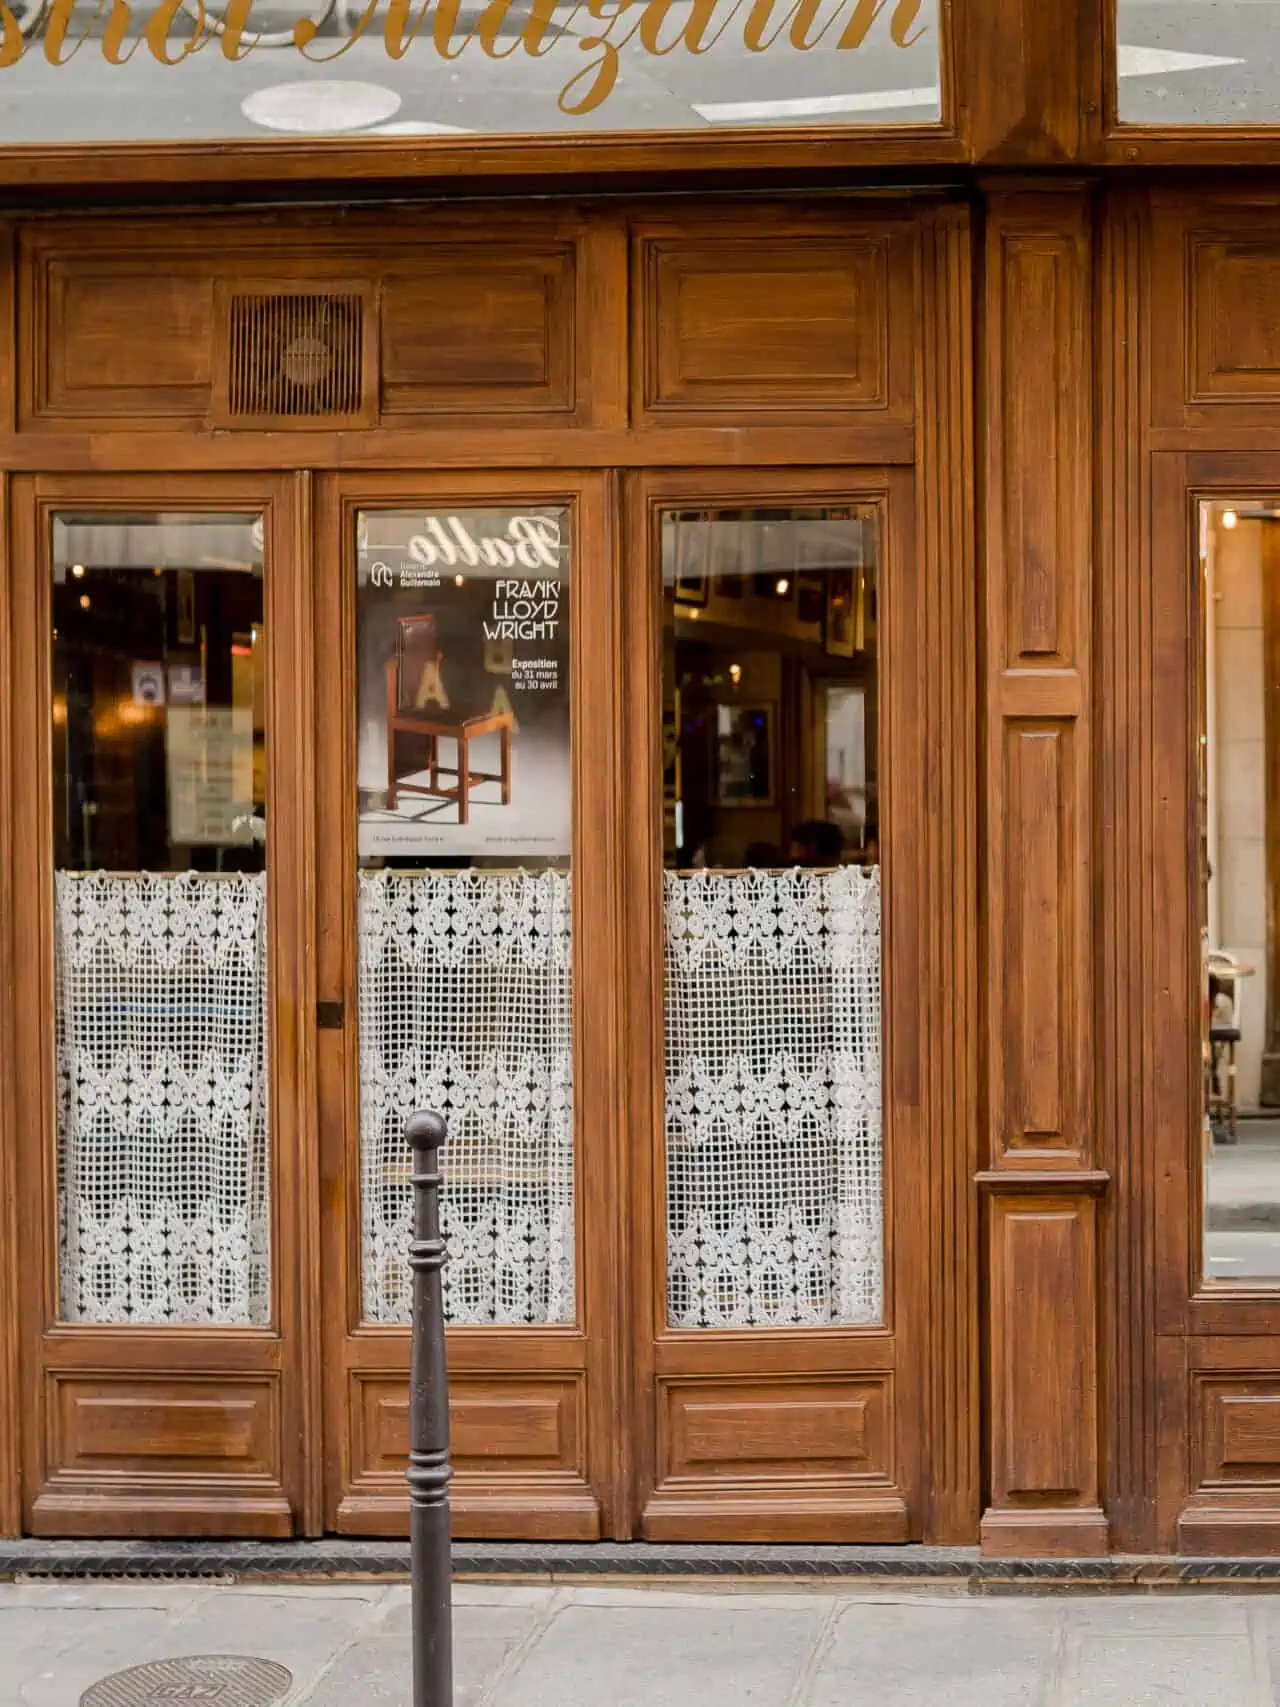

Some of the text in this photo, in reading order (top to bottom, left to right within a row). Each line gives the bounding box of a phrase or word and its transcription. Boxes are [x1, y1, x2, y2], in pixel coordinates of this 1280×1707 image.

[495, 579, 559, 599] FRANK
[493, 600, 559, 619] LLOYD
[482, 620, 559, 640] WRIGHT
[511, 658, 558, 671] Exposition
[511, 670, 522, 679] du
[535, 671, 558, 679] mars
